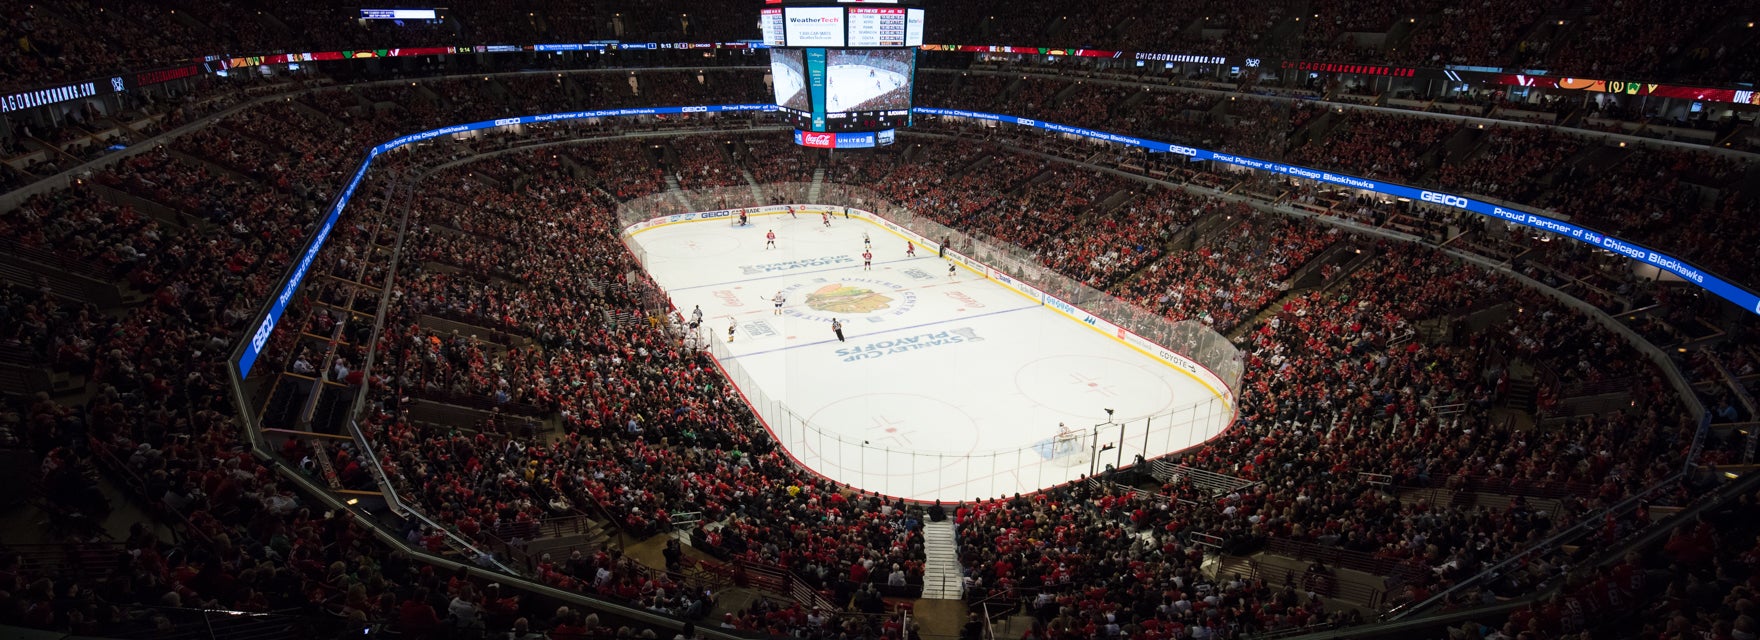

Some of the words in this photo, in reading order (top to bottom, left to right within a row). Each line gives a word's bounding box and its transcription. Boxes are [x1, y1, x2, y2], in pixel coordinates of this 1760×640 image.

[1135, 52, 1226, 65] CHICAGOBLACKHAWKS.COM
[1281, 60, 1416, 78] CHICAGOBLACKHAWKS.COM
[1733, 89, 1752, 104] ONE
[494, 117, 521, 127] GEICO
[954, 110, 972, 118] Chicago
[973, 112, 1000, 120] Blackhawks
[1017, 117, 1035, 127] GEICO
[413, 133, 422, 141] the
[421, 129, 440, 140] Chicago
[439, 125, 469, 136] Blackhawks
[1044, 122, 1058, 131] Proud
[1058, 123, 1076, 134] Partner
[1082, 128, 1091, 137] the
[1090, 130, 1110, 140] Chicago
[1110, 132, 1141, 146] Blackhawks
[1169, 144, 1197, 157] GEICO
[1212, 153, 1234, 163] Proud
[1235, 156, 1263, 169] Partner
[1264, 163, 1273, 171] of
[1274, 164, 1288, 174] the
[1288, 166, 1321, 180] Chicago
[1323, 173, 1375, 190] Blackhawks
[1420, 190, 1468, 209] GEICO
[701, 210, 729, 219] GEICO
[1493, 207, 1526, 223] Proud
[1527, 215, 1571, 234] Partner
[1572, 229, 1583, 238] of
[1584, 232, 1601, 244] the
[1603, 237, 1646, 260] Chicago
[1648, 252, 1704, 284] Blackhawks
[280, 283, 292, 307] Proud
[289, 267, 303, 290] Partner
[301, 259, 306, 272] of
[308, 240, 320, 259] Chicago
[317, 222, 331, 245] Blackhawks
[756, 258, 817, 269] STANLEY
[819, 254, 849, 262] CUP
[765, 257, 854, 273] PLAYOFFS
[840, 277, 902, 290] UNITED
[895, 291, 918, 317] CENTER
[252, 312, 274, 354] GEICO
[834, 331, 950, 357] PLAYOFFS
[886, 335, 965, 355] STANLEY
[842, 350, 884, 363] CUP
[1159, 349, 1189, 369] COYOTE
